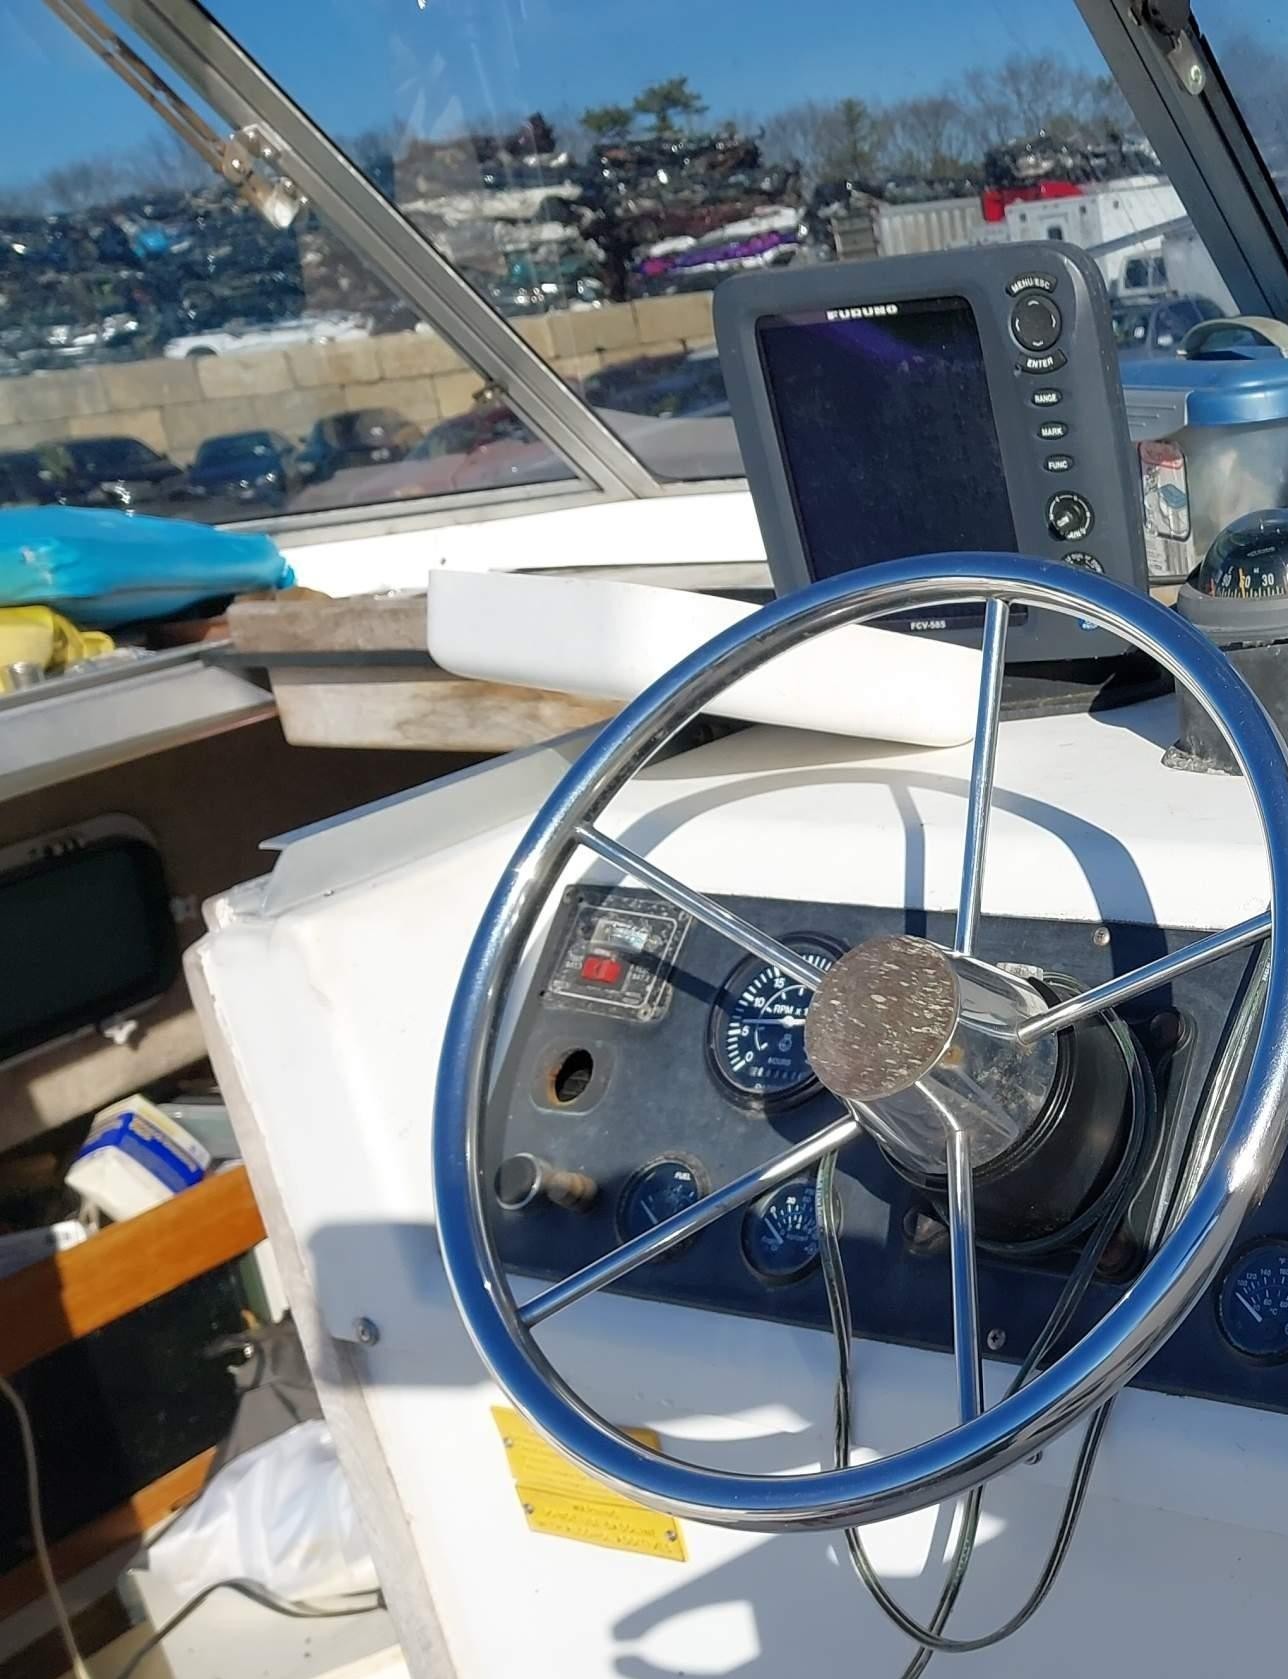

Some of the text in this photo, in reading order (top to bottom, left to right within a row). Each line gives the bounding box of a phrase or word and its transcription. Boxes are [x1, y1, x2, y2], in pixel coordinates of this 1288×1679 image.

[826, 304, 898, 321] FURUNO
[1026, 356, 1053, 368] ENTER
[1034, 393, 1058, 403] RANGE
[1041, 426, 1063, 436] MARK
[1048, 460, 1068, 469] FUNC
[1261, 574, 1275, 586] 30
[773, 977, 785, 989] 15
[754, 996, 765, 1008] 10
[773, 1004, 793, 1014] RPM
[741, 1025, 749, 1036] 5
[745, 1051, 754, 1062] 0
